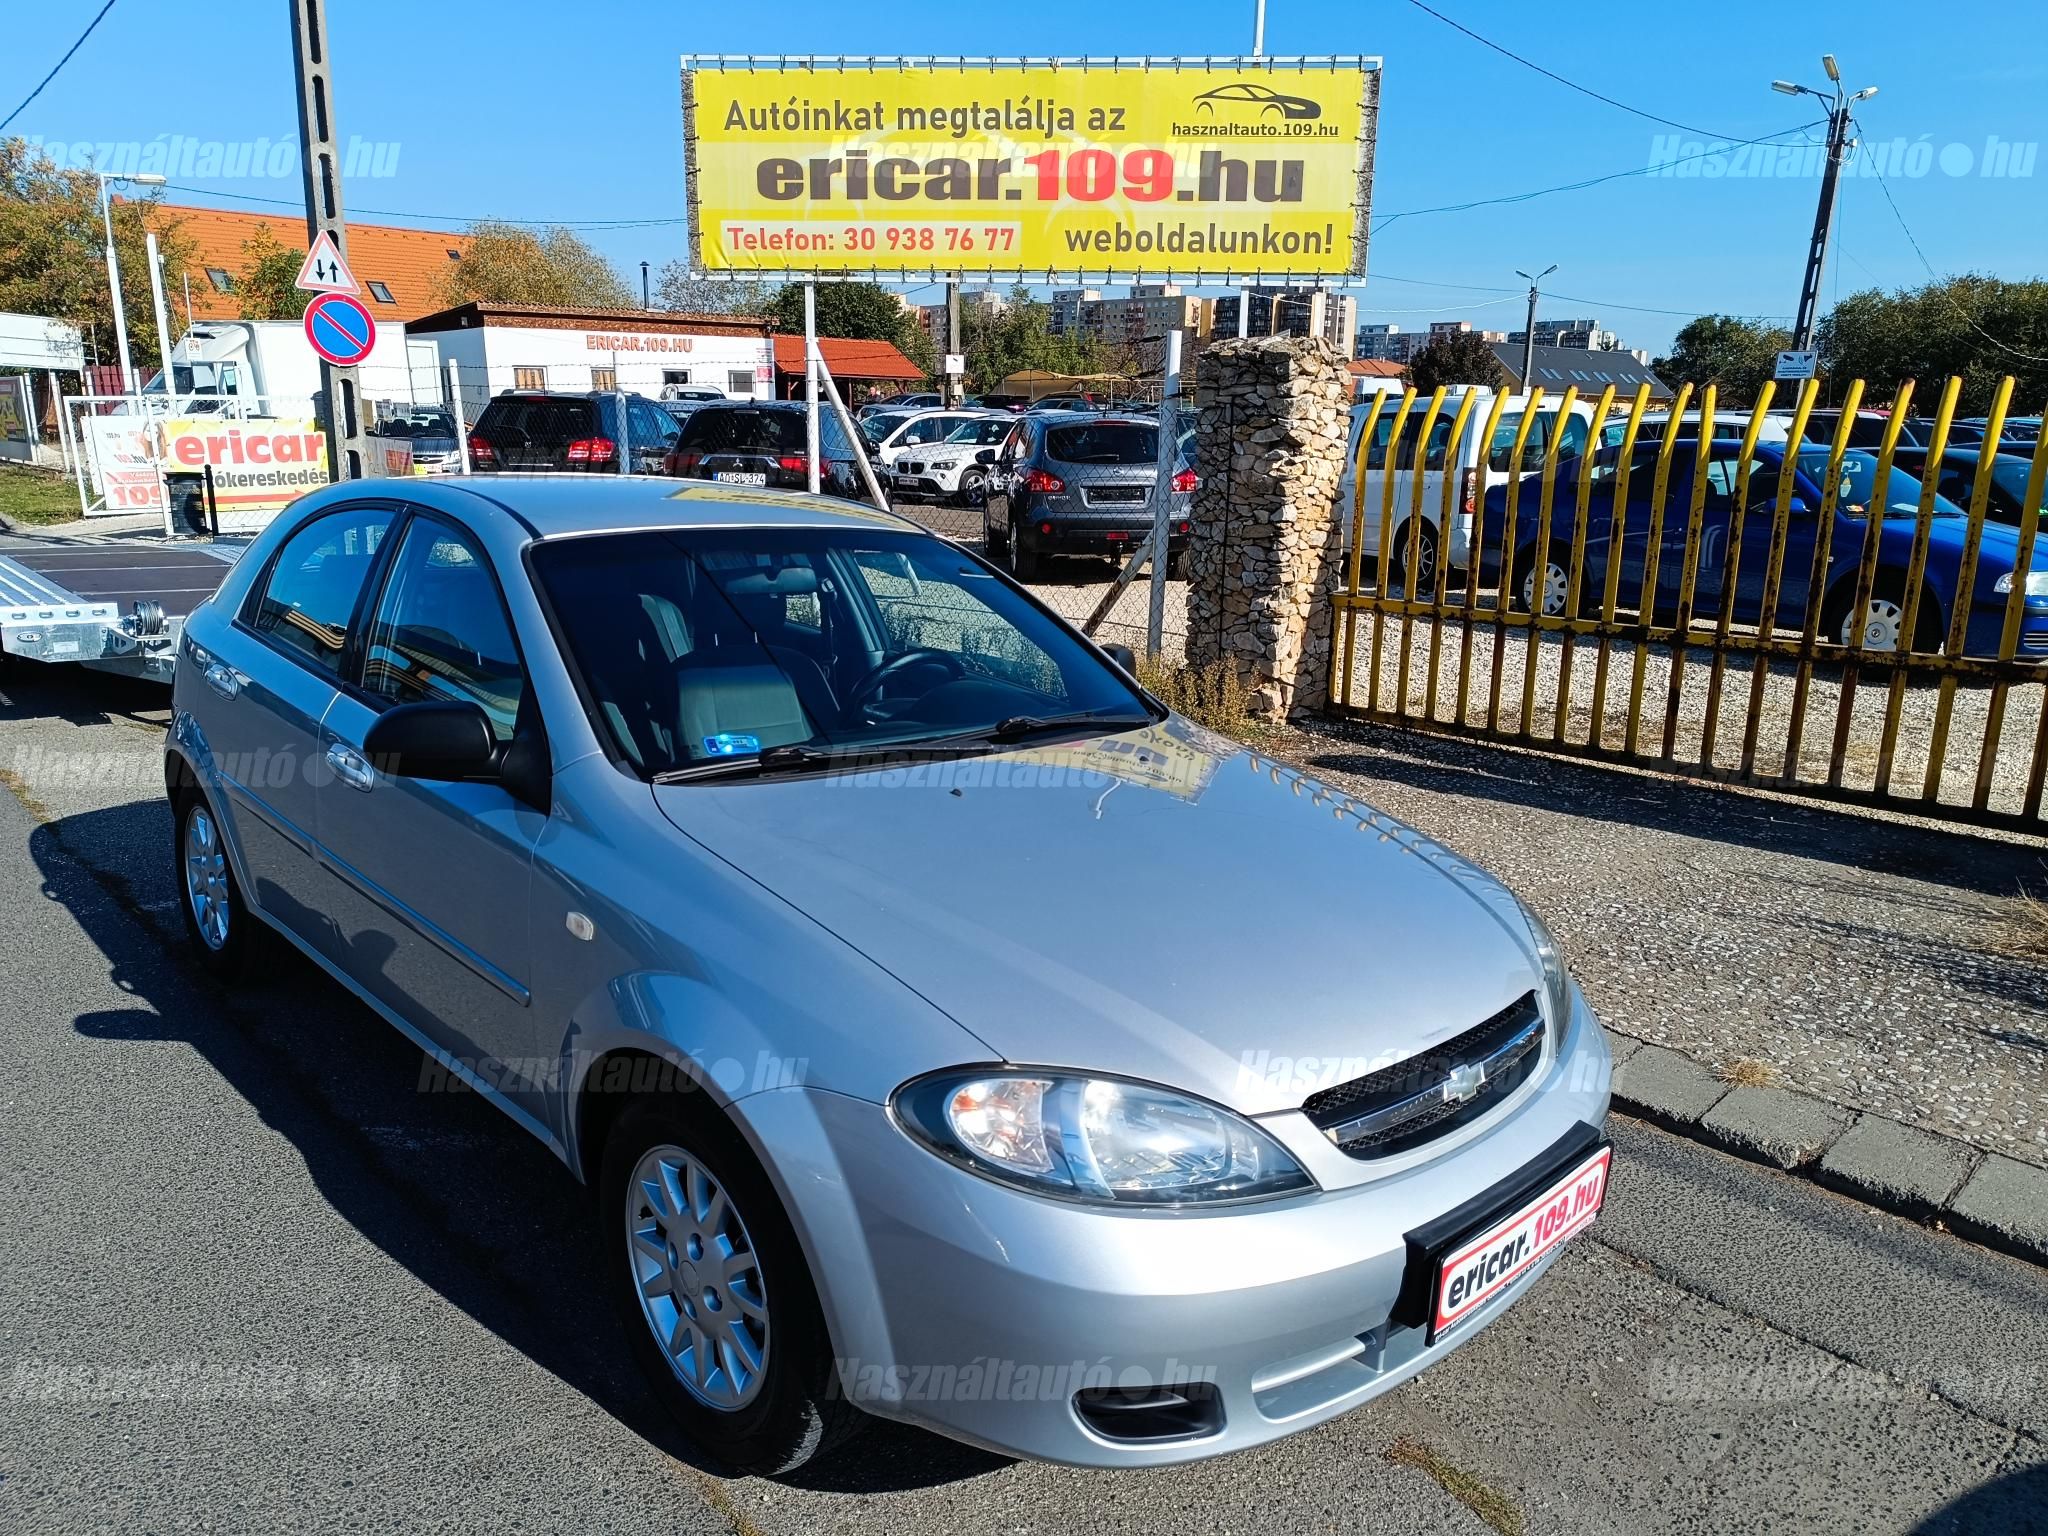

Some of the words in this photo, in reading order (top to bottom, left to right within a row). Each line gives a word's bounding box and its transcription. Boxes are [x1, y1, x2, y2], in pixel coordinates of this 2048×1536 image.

[724, 99, 884, 131] Autóinkat
[897, 98, 1076, 134] megtalálja
[1088, 107, 1126, 131] az
[1171, 122, 1339, 137] hasznaltauto.109.hu
[756, 149, 1303, 202] ericar.109.hu
[727, 227, 834, 251] Telefon:
[843, 227, 874, 250] 30
[886, 227, 934, 250] 938
[945, 227, 975, 250] 76
[984, 226, 1014, 250] 77
[1064, 223, 1333, 255] weboldalunkon!
[586, 335, 693, 353] ERICAR.109.HU
[175, 430, 324, 466] ericar
[203, 468, 329, 489] ókereskedés
